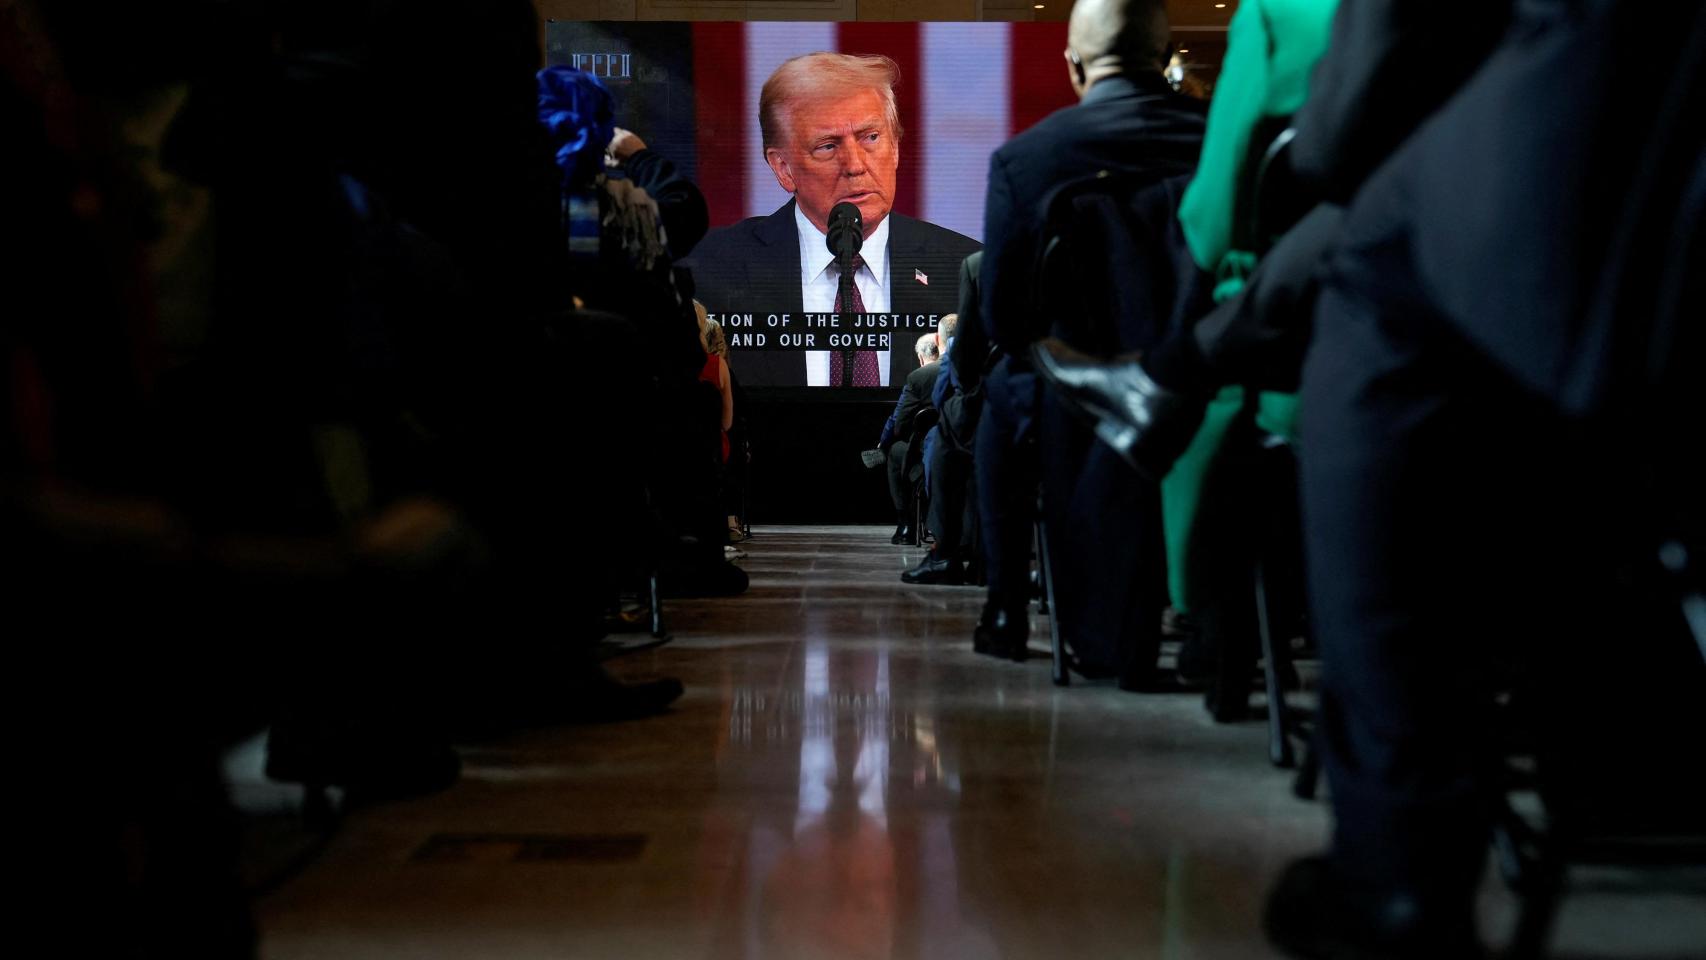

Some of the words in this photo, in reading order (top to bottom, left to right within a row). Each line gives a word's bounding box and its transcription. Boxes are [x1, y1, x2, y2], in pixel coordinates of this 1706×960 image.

[767, 314, 791, 327] OF
[804, 314, 840, 327] THE
[853, 314, 938, 327] JUSTICE
[731, 333, 766, 346] AND
[779, 333, 815, 346] OUR
[829, 333, 889, 346] GOVER
